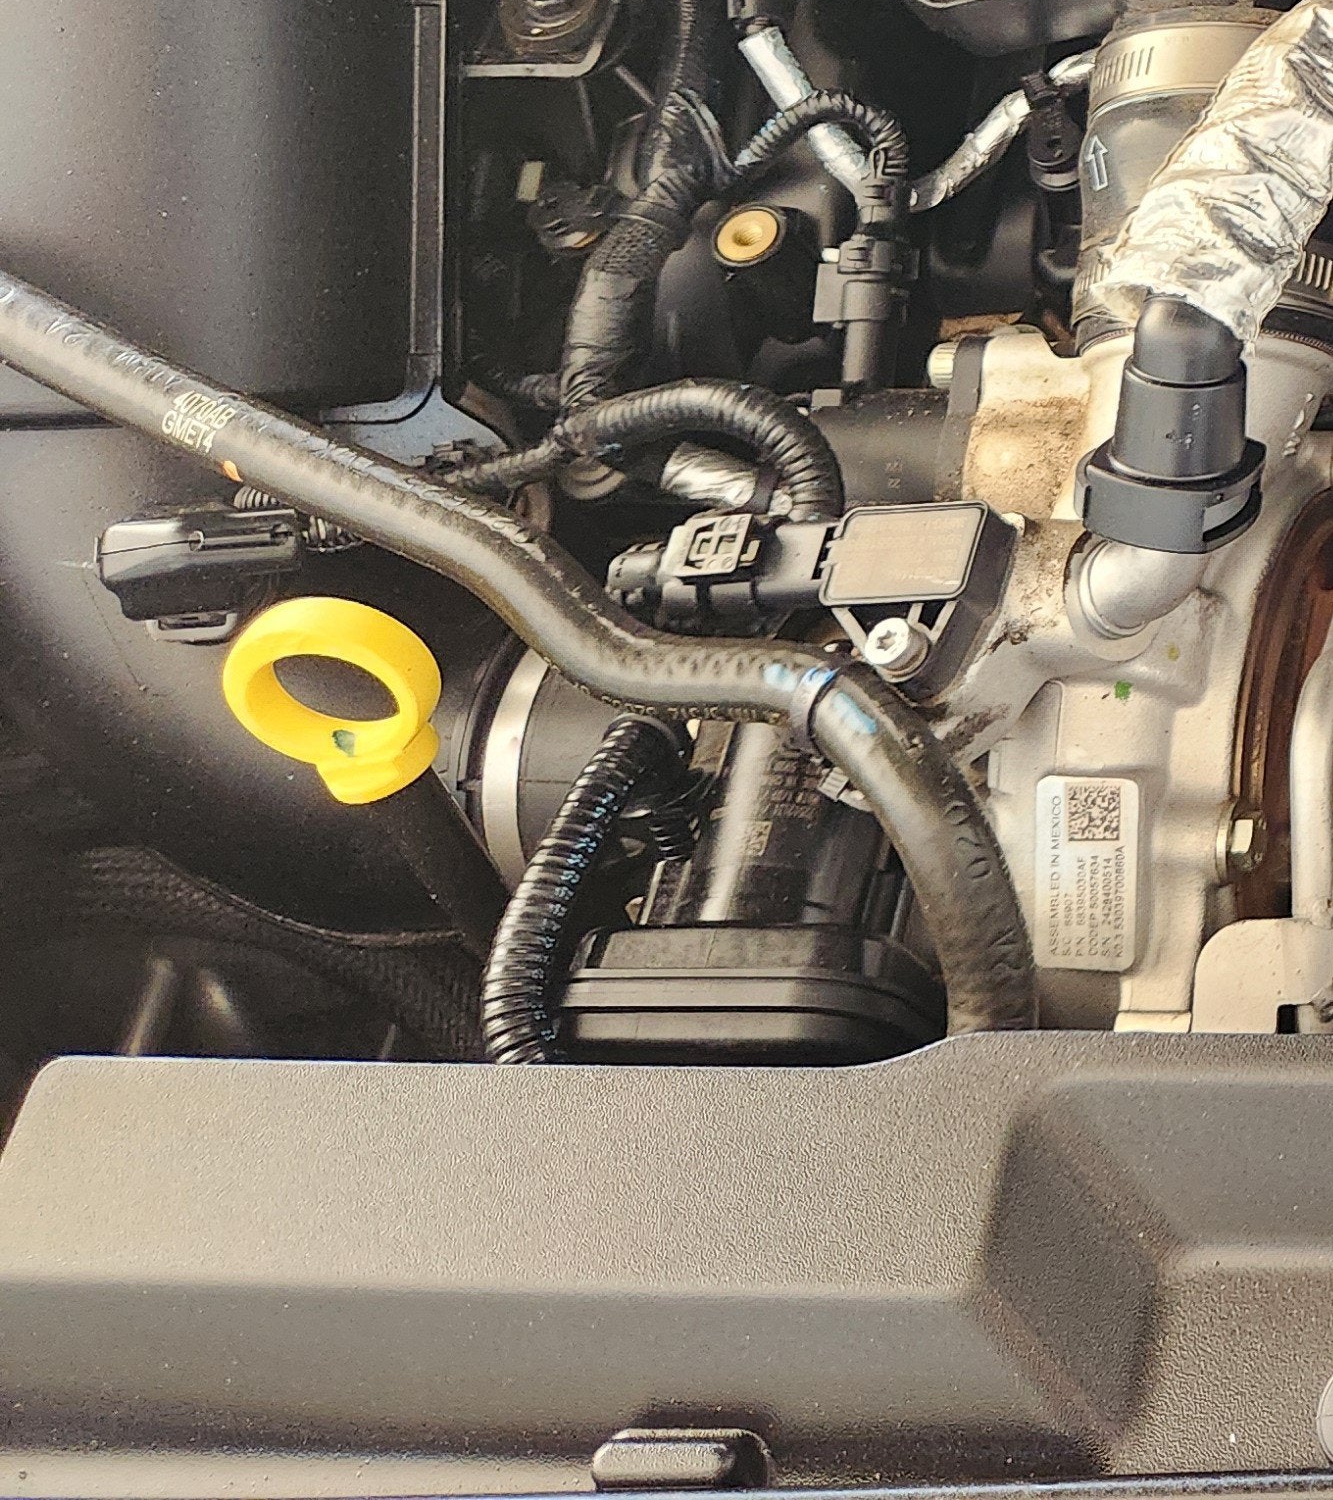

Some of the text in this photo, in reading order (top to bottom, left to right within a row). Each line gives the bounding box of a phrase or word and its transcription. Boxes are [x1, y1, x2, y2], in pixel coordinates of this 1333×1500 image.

[171, 390, 237, 431] 4070AB
[161, 411, 217, 454] GMET4
[1048, 795, 1061, 955] ASSEMBLED IN MEXICO
